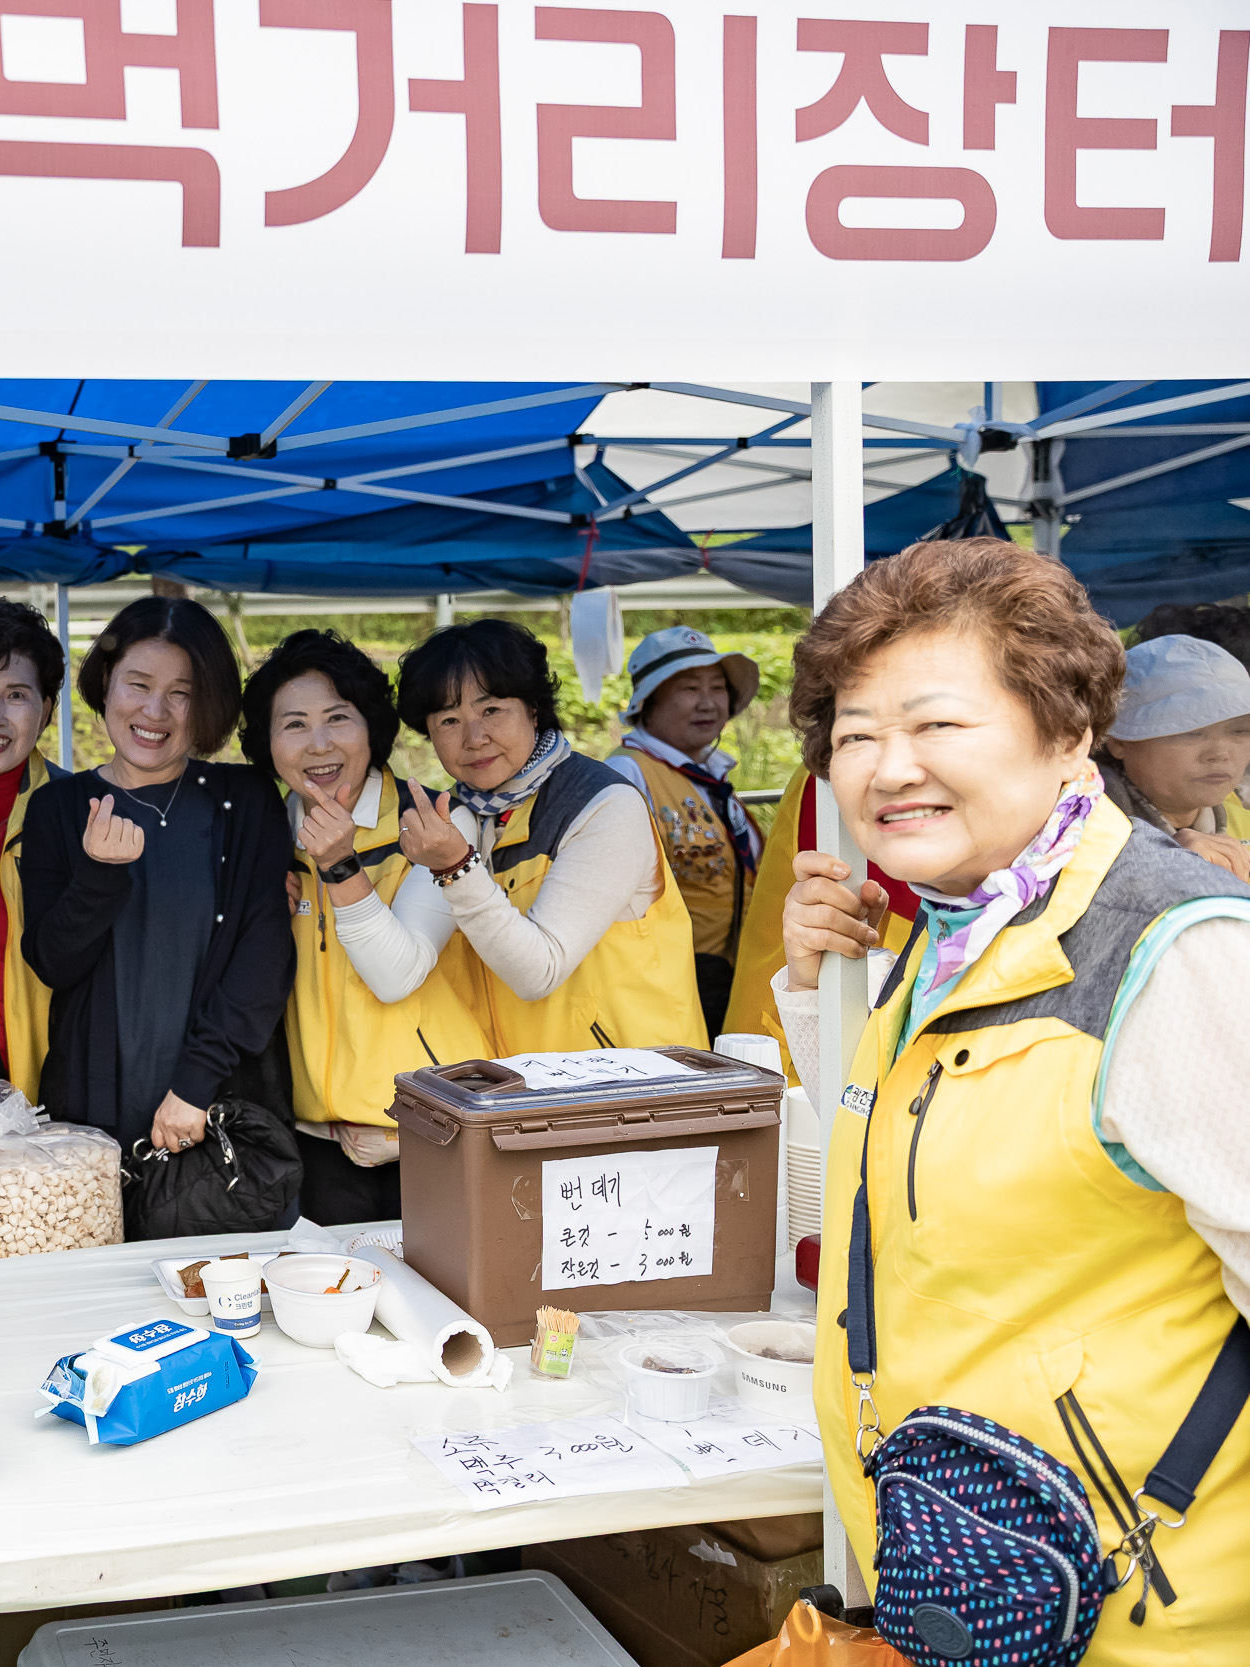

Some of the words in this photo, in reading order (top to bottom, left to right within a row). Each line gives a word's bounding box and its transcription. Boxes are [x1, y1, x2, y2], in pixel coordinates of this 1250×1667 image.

[560, 1224, 590, 1248] 큰것
[561, 1257, 600, 1280] 작은것
[741, 1372, 787, 1393] SAMSUNG
[442, 1435, 499, 1457] 소주
[459, 1455, 523, 1476] 맥주
[473, 1470, 556, 1495] 막걸리
